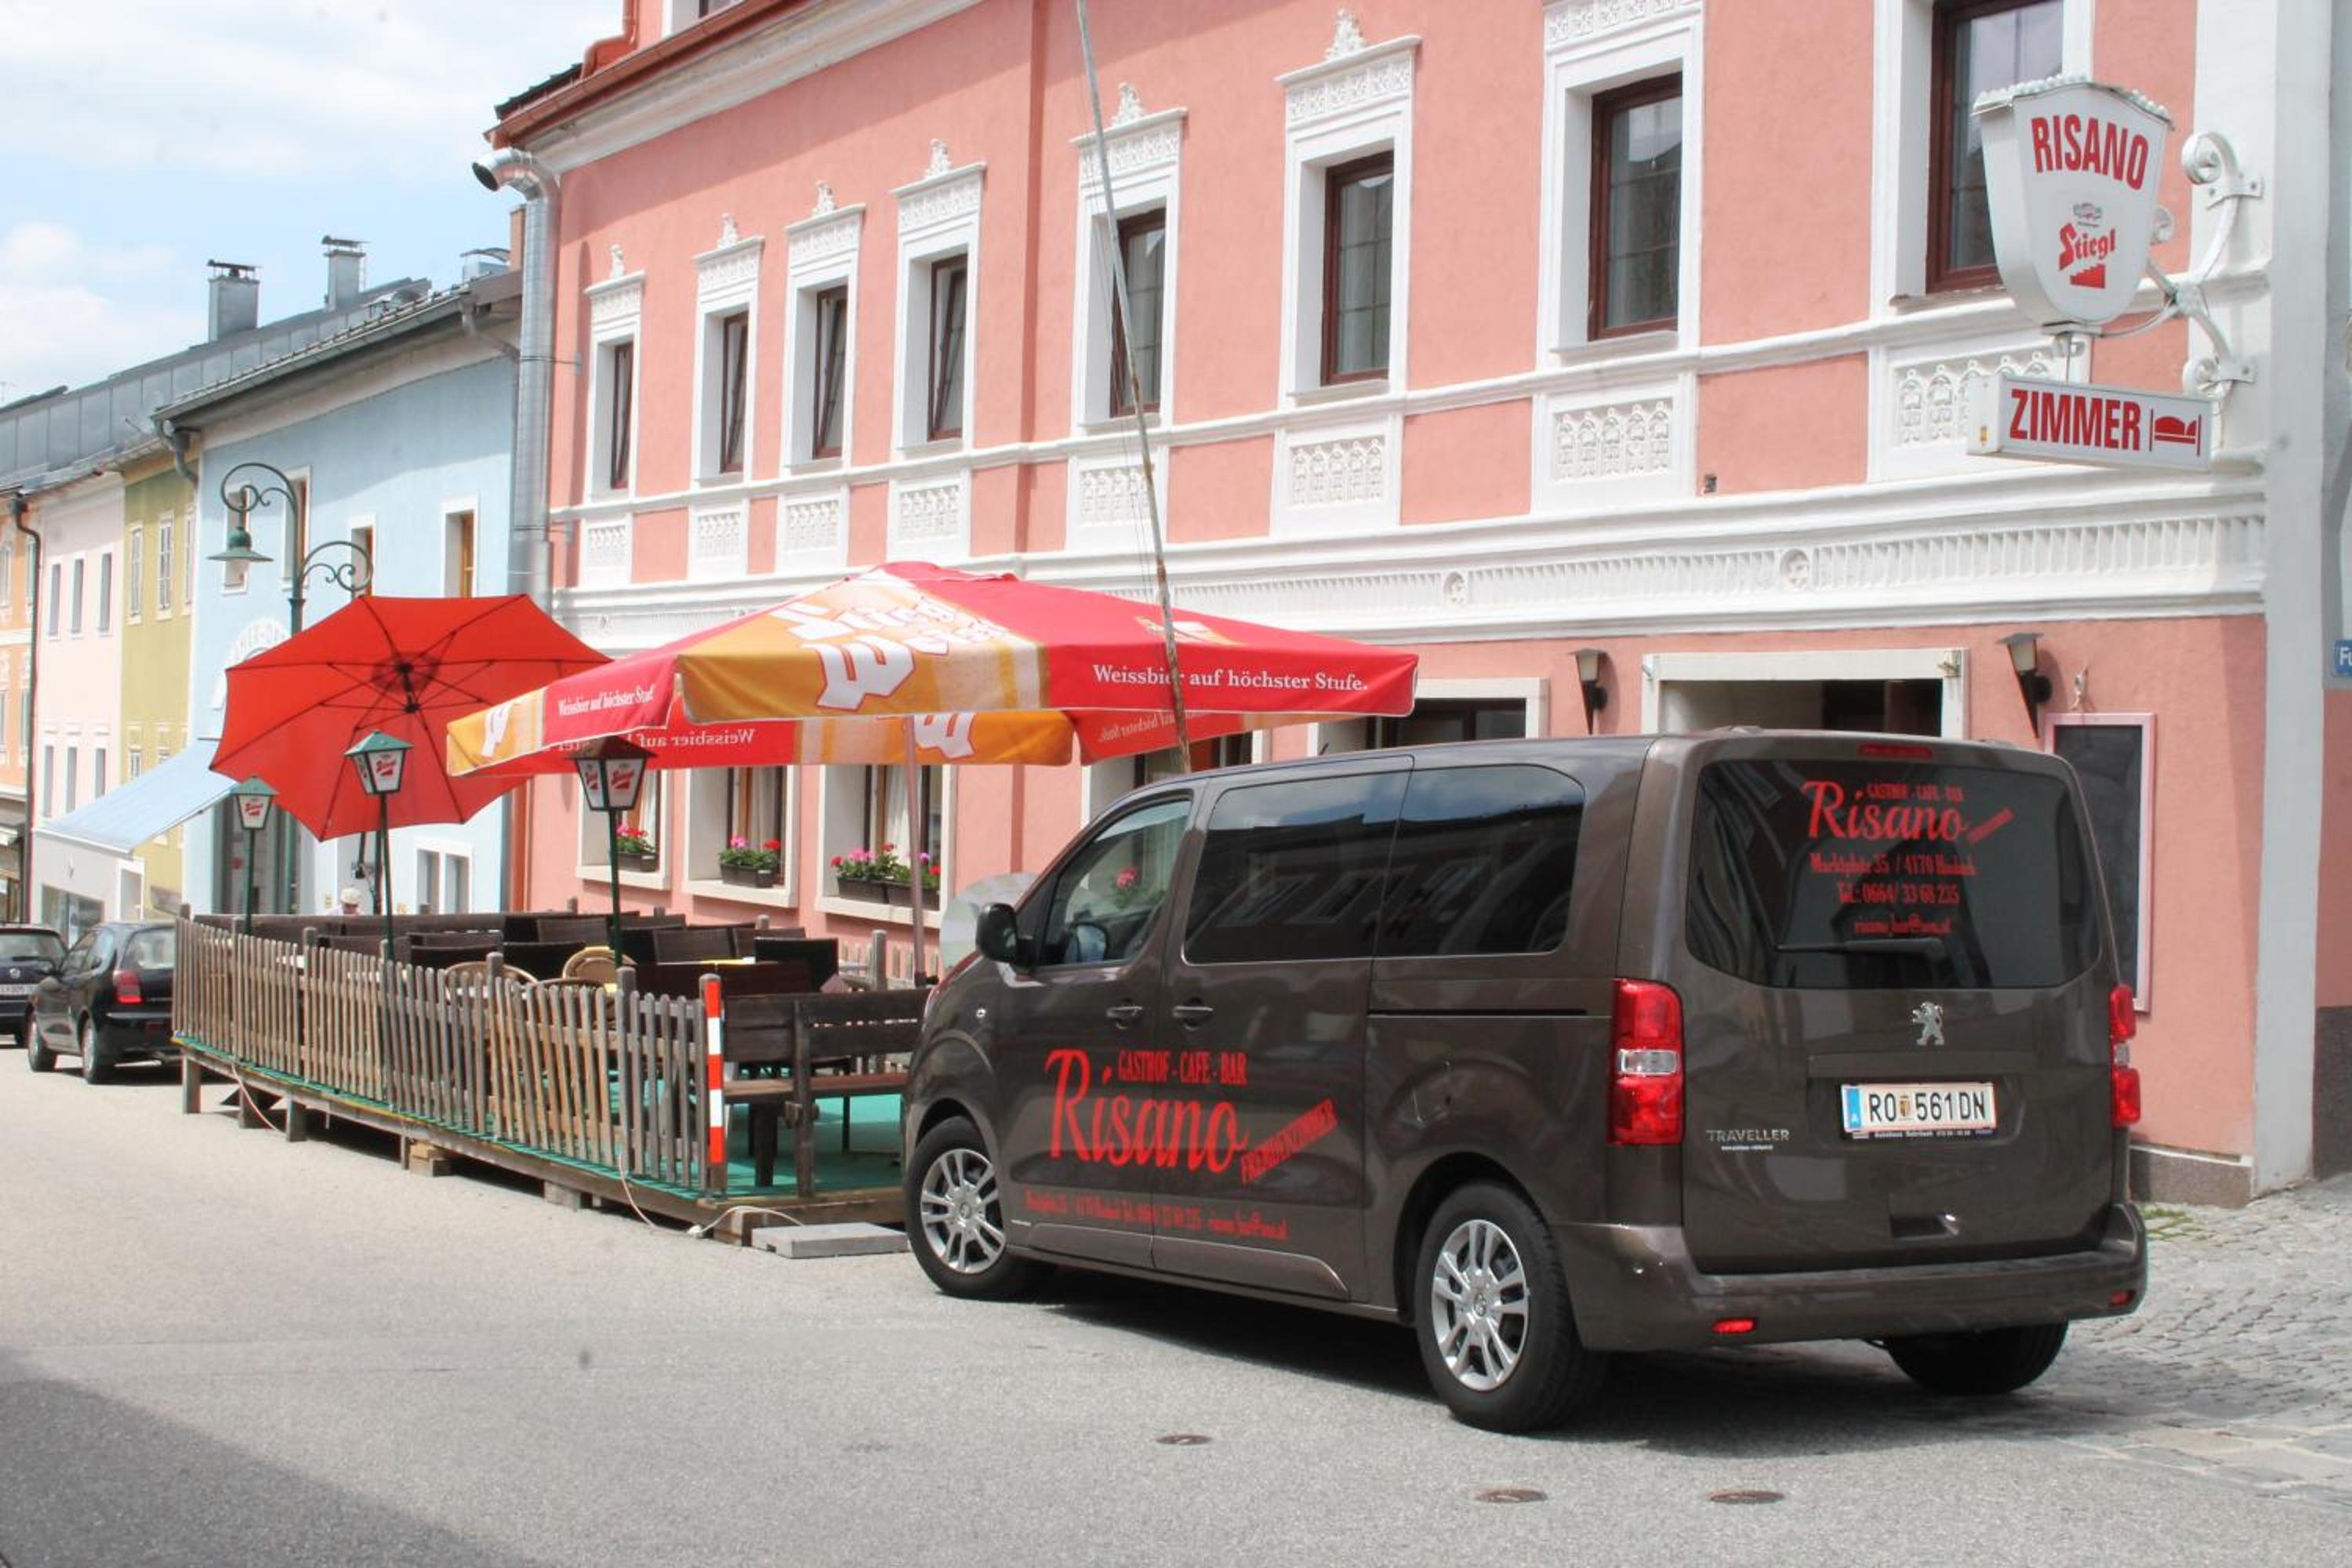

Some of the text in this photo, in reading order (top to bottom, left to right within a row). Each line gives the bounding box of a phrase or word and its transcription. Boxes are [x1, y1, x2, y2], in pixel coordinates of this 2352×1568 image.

[2031, 114, 2149, 190] RISANO
[2059, 223, 2116, 271] Stiegl
[2009, 388, 2141, 452] ZIMMER
[1189, 669, 1224, 687] auf
[1228, 669, 1311, 690] höchster
[1315, 672, 1369, 691] Stufe.
[1800, 779, 1967, 843] Risano
[1116, 1049, 1171, 1083] GASTHOF
[1179, 1050, 1210, 1086] CAFE
[1219, 1051, 1248, 1087] BAR
[1043, 1047, 1248, 1174] Risano
[1868, 1093, 1897, 1123] RO
[1705, 1129, 1790, 1142] TRAVELLER
